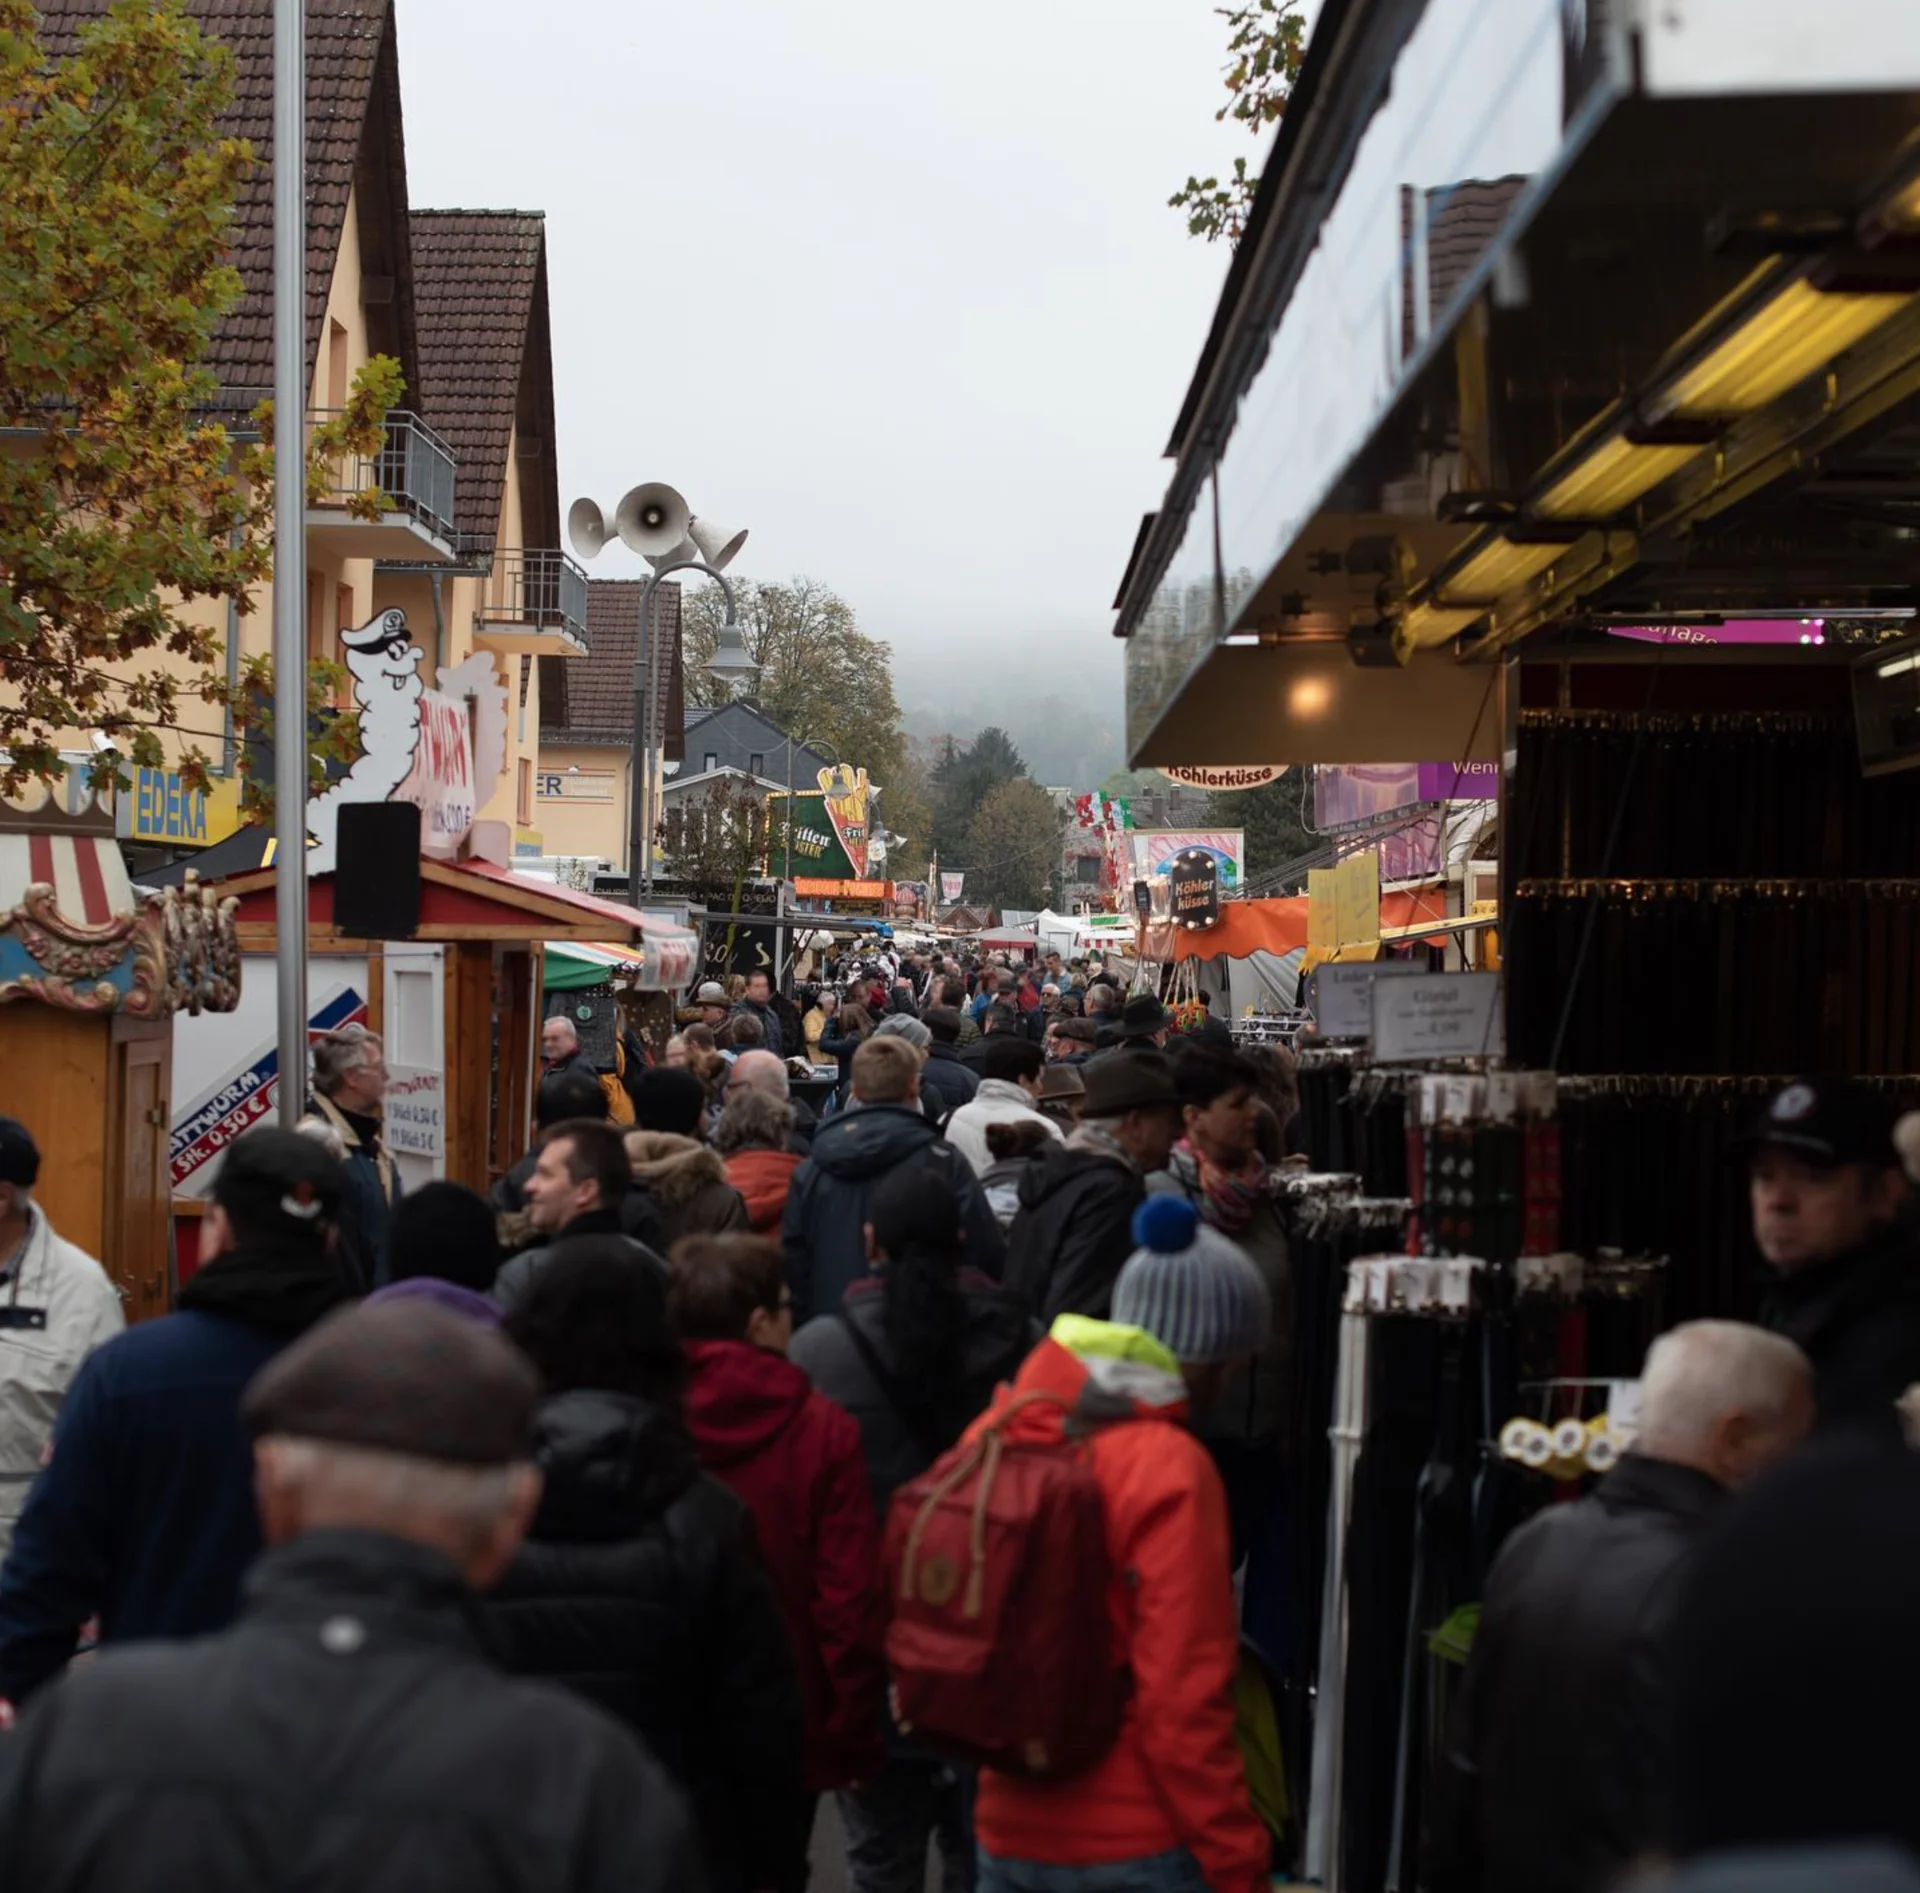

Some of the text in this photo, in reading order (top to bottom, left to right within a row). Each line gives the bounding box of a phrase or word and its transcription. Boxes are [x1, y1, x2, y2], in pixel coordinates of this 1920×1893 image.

[137, 767, 206, 840] EDEKA
[1175, 879, 1214, 895] Köhler
[1177, 895, 1210, 911] küsse
[176, 1147, 212, 1173] Stk.
[208, 1109, 250, 1146] 0,50
[247, 1096, 265, 1114] €
